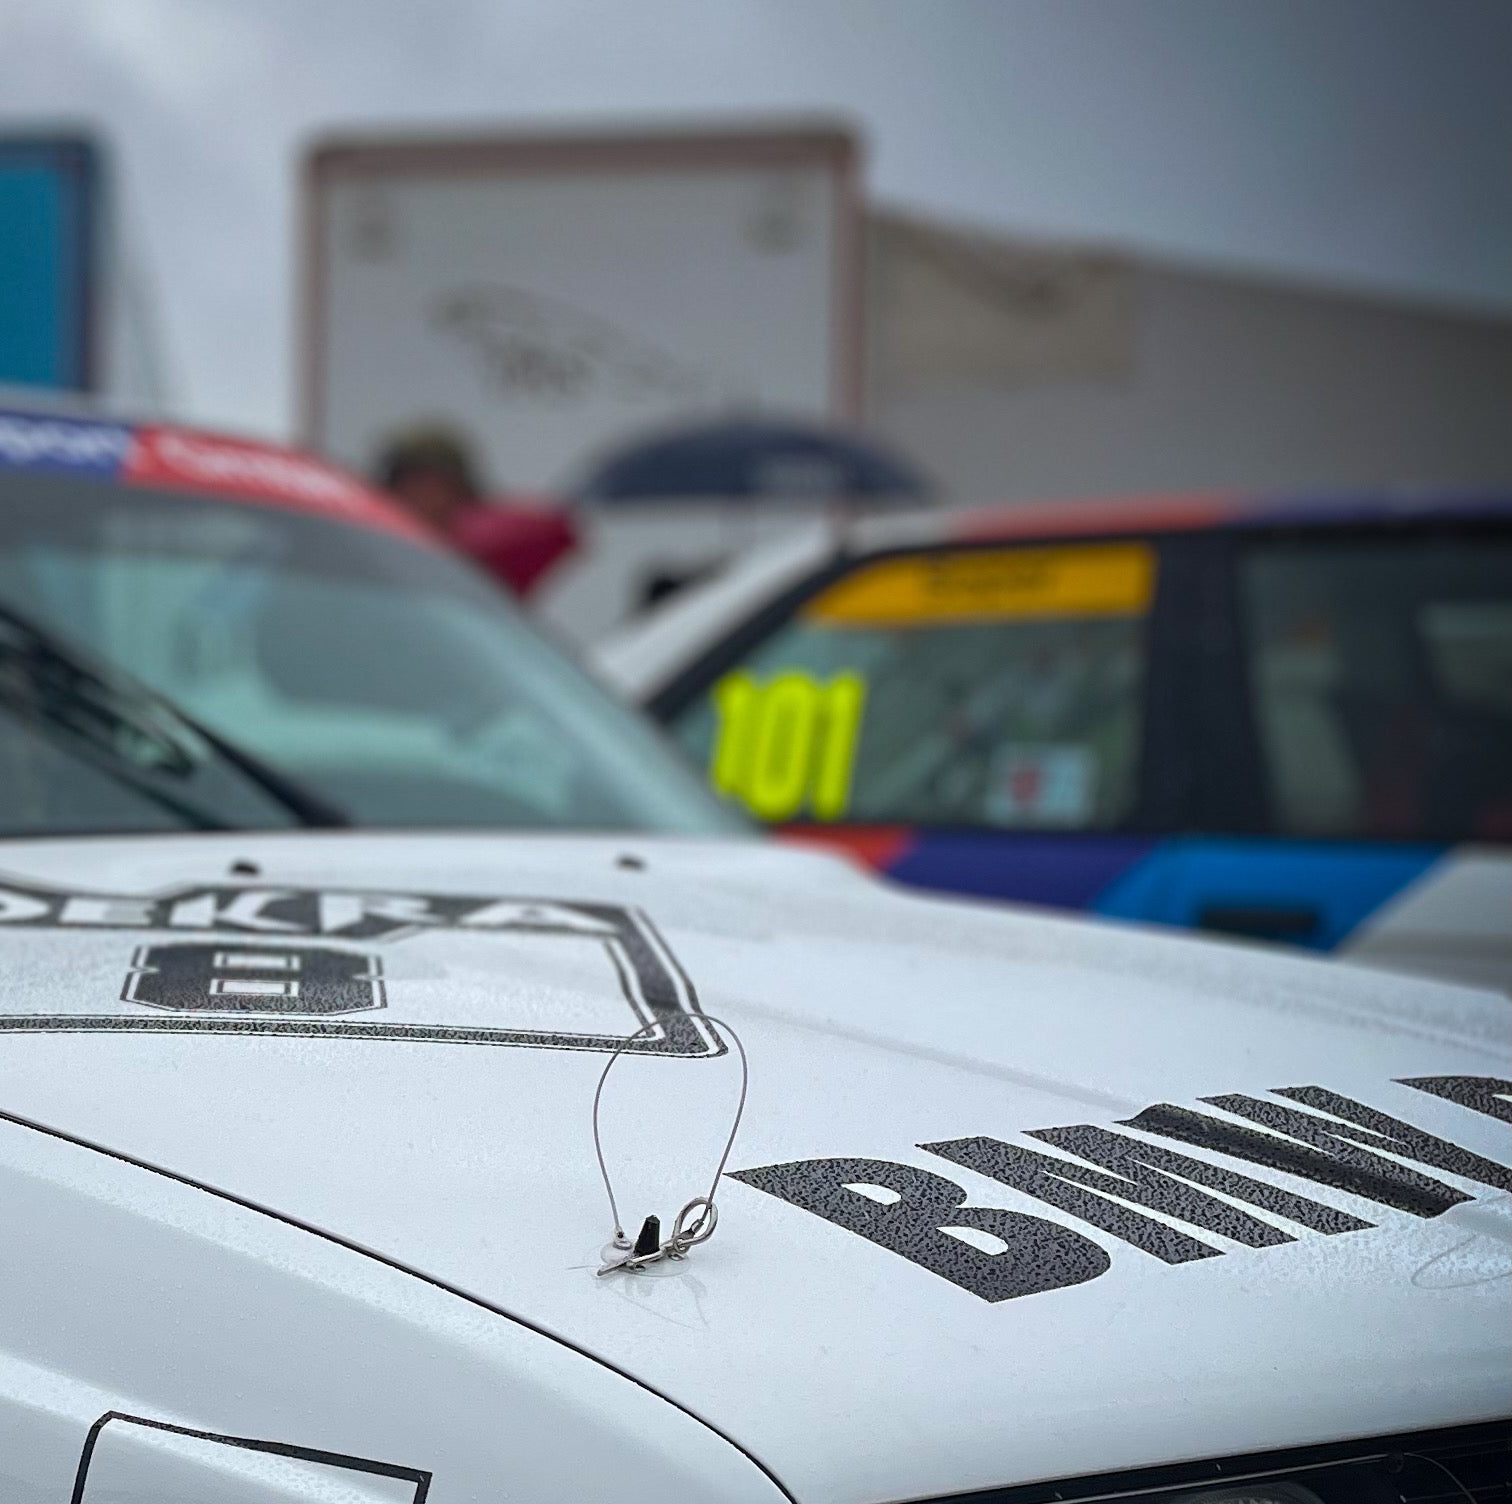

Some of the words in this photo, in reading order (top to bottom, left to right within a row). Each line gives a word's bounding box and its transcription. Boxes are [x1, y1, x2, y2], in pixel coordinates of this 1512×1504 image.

[710, 667, 867, 822] 101
[120, 941, 388, 1017] 8
[723, 1074, 1512, 1303] BMW
